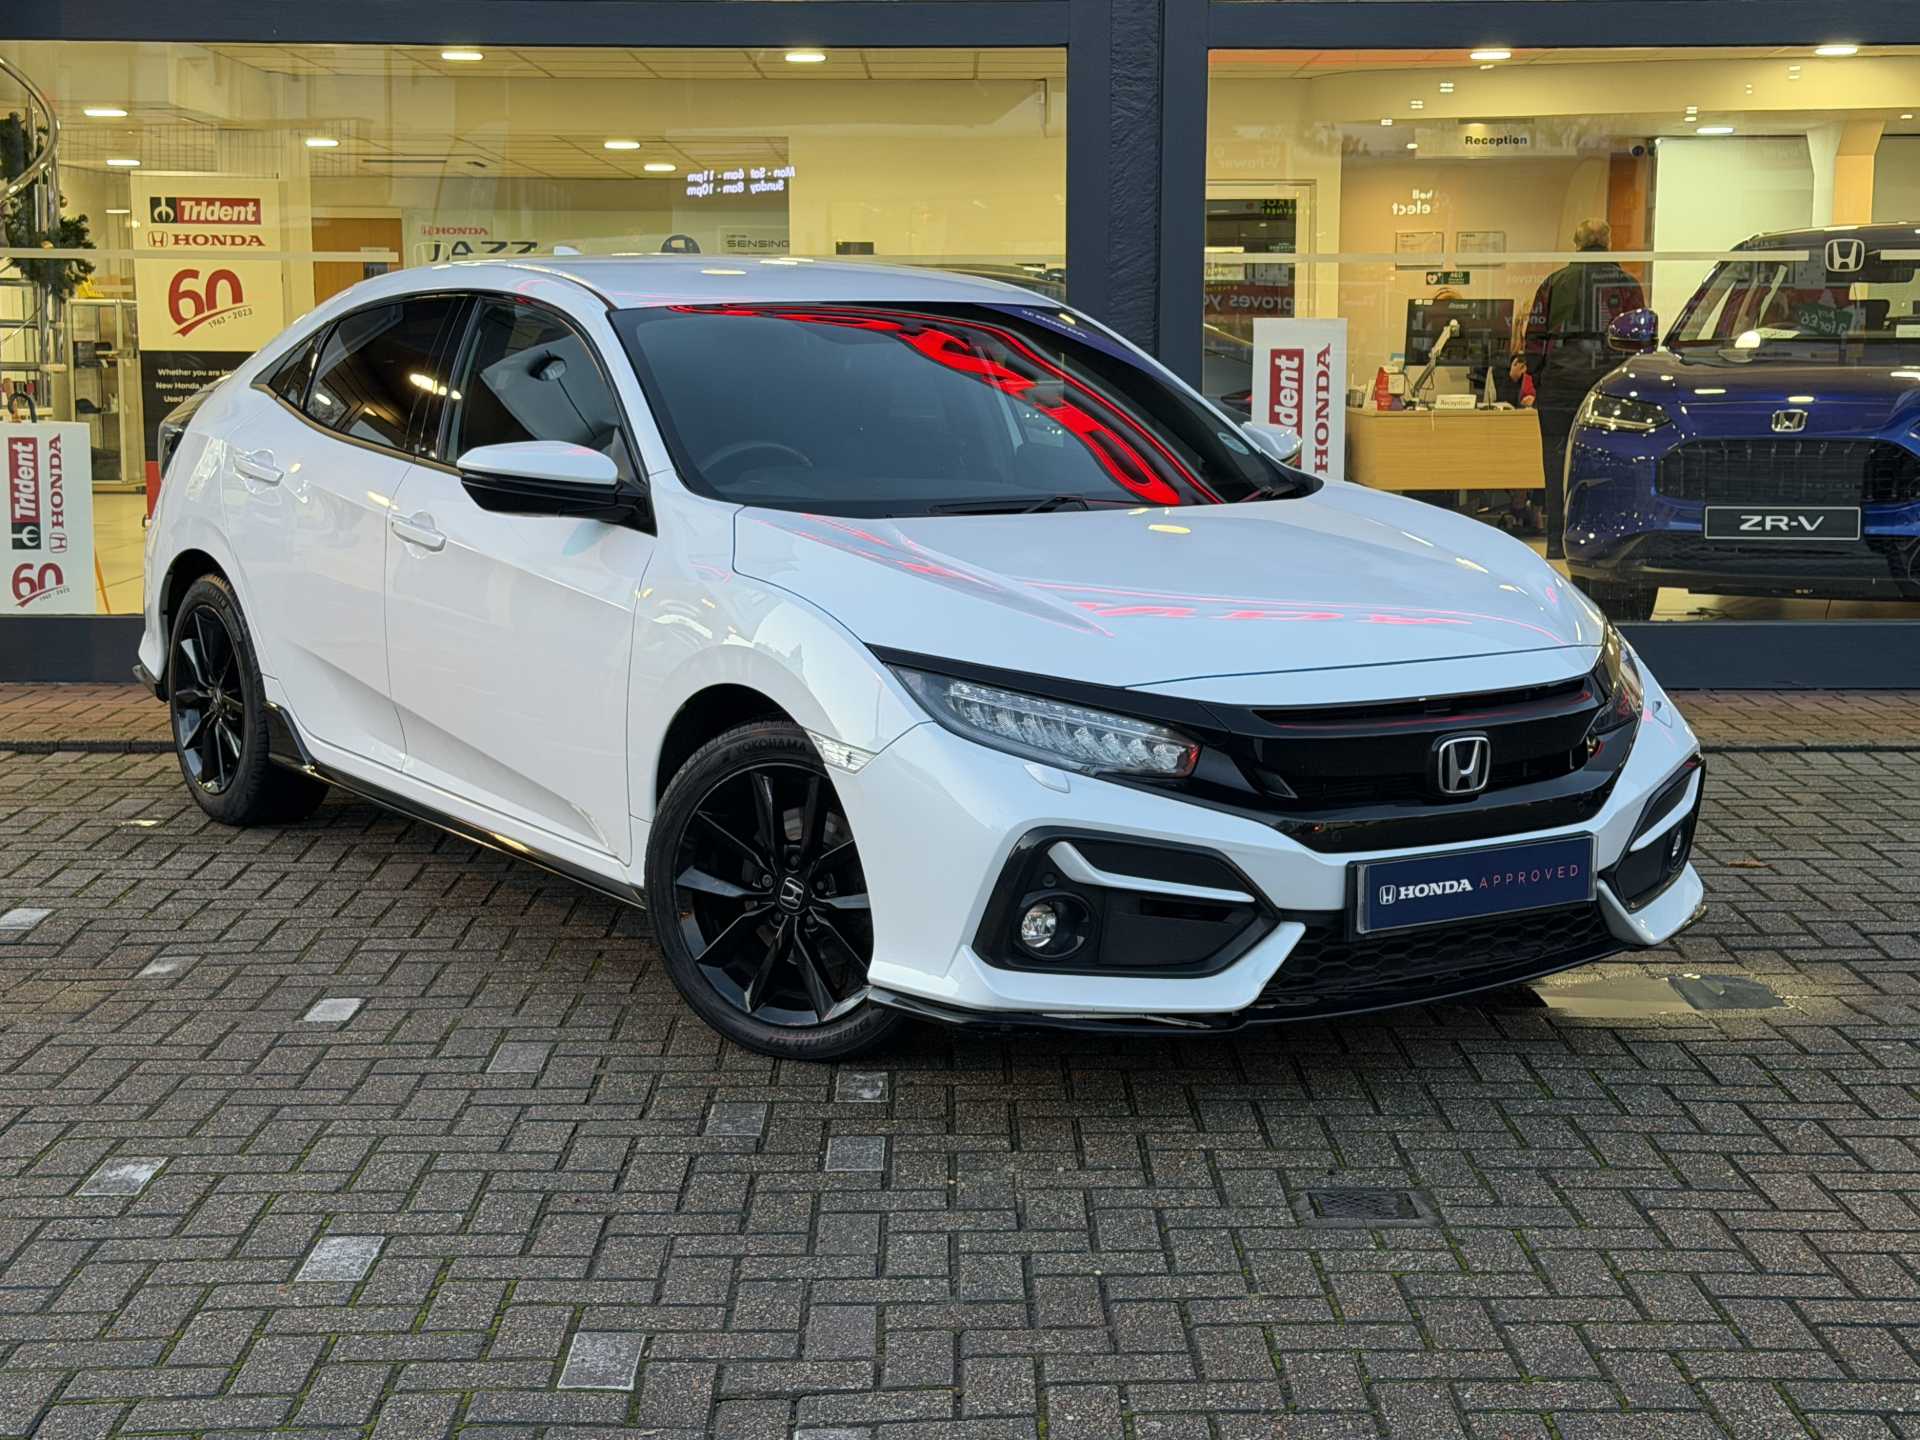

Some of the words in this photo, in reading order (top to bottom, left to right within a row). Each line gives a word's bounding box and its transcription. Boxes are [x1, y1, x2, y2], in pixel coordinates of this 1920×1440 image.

[1465, 135, 1528, 147] Reception
[180, 200, 257, 222] Trident
[171, 233, 266, 247] HONDA
[432, 226, 489, 236] HONDA
[168, 268, 244, 326] 60
[158, 368, 191, 376] Whether
[192, 369, 207, 377] you
[1274, 354, 1301, 428] dent
[1314, 343, 1332, 473] HONDA
[12, 442, 37, 520] Trident
[50, 433, 65, 529] HONDA
[1738, 515, 1825, 531] ZR-V
[12, 562, 64, 600] 60
[1399, 878, 1474, 900] HONDA
[1479, 864, 1580, 889] APPROVED
